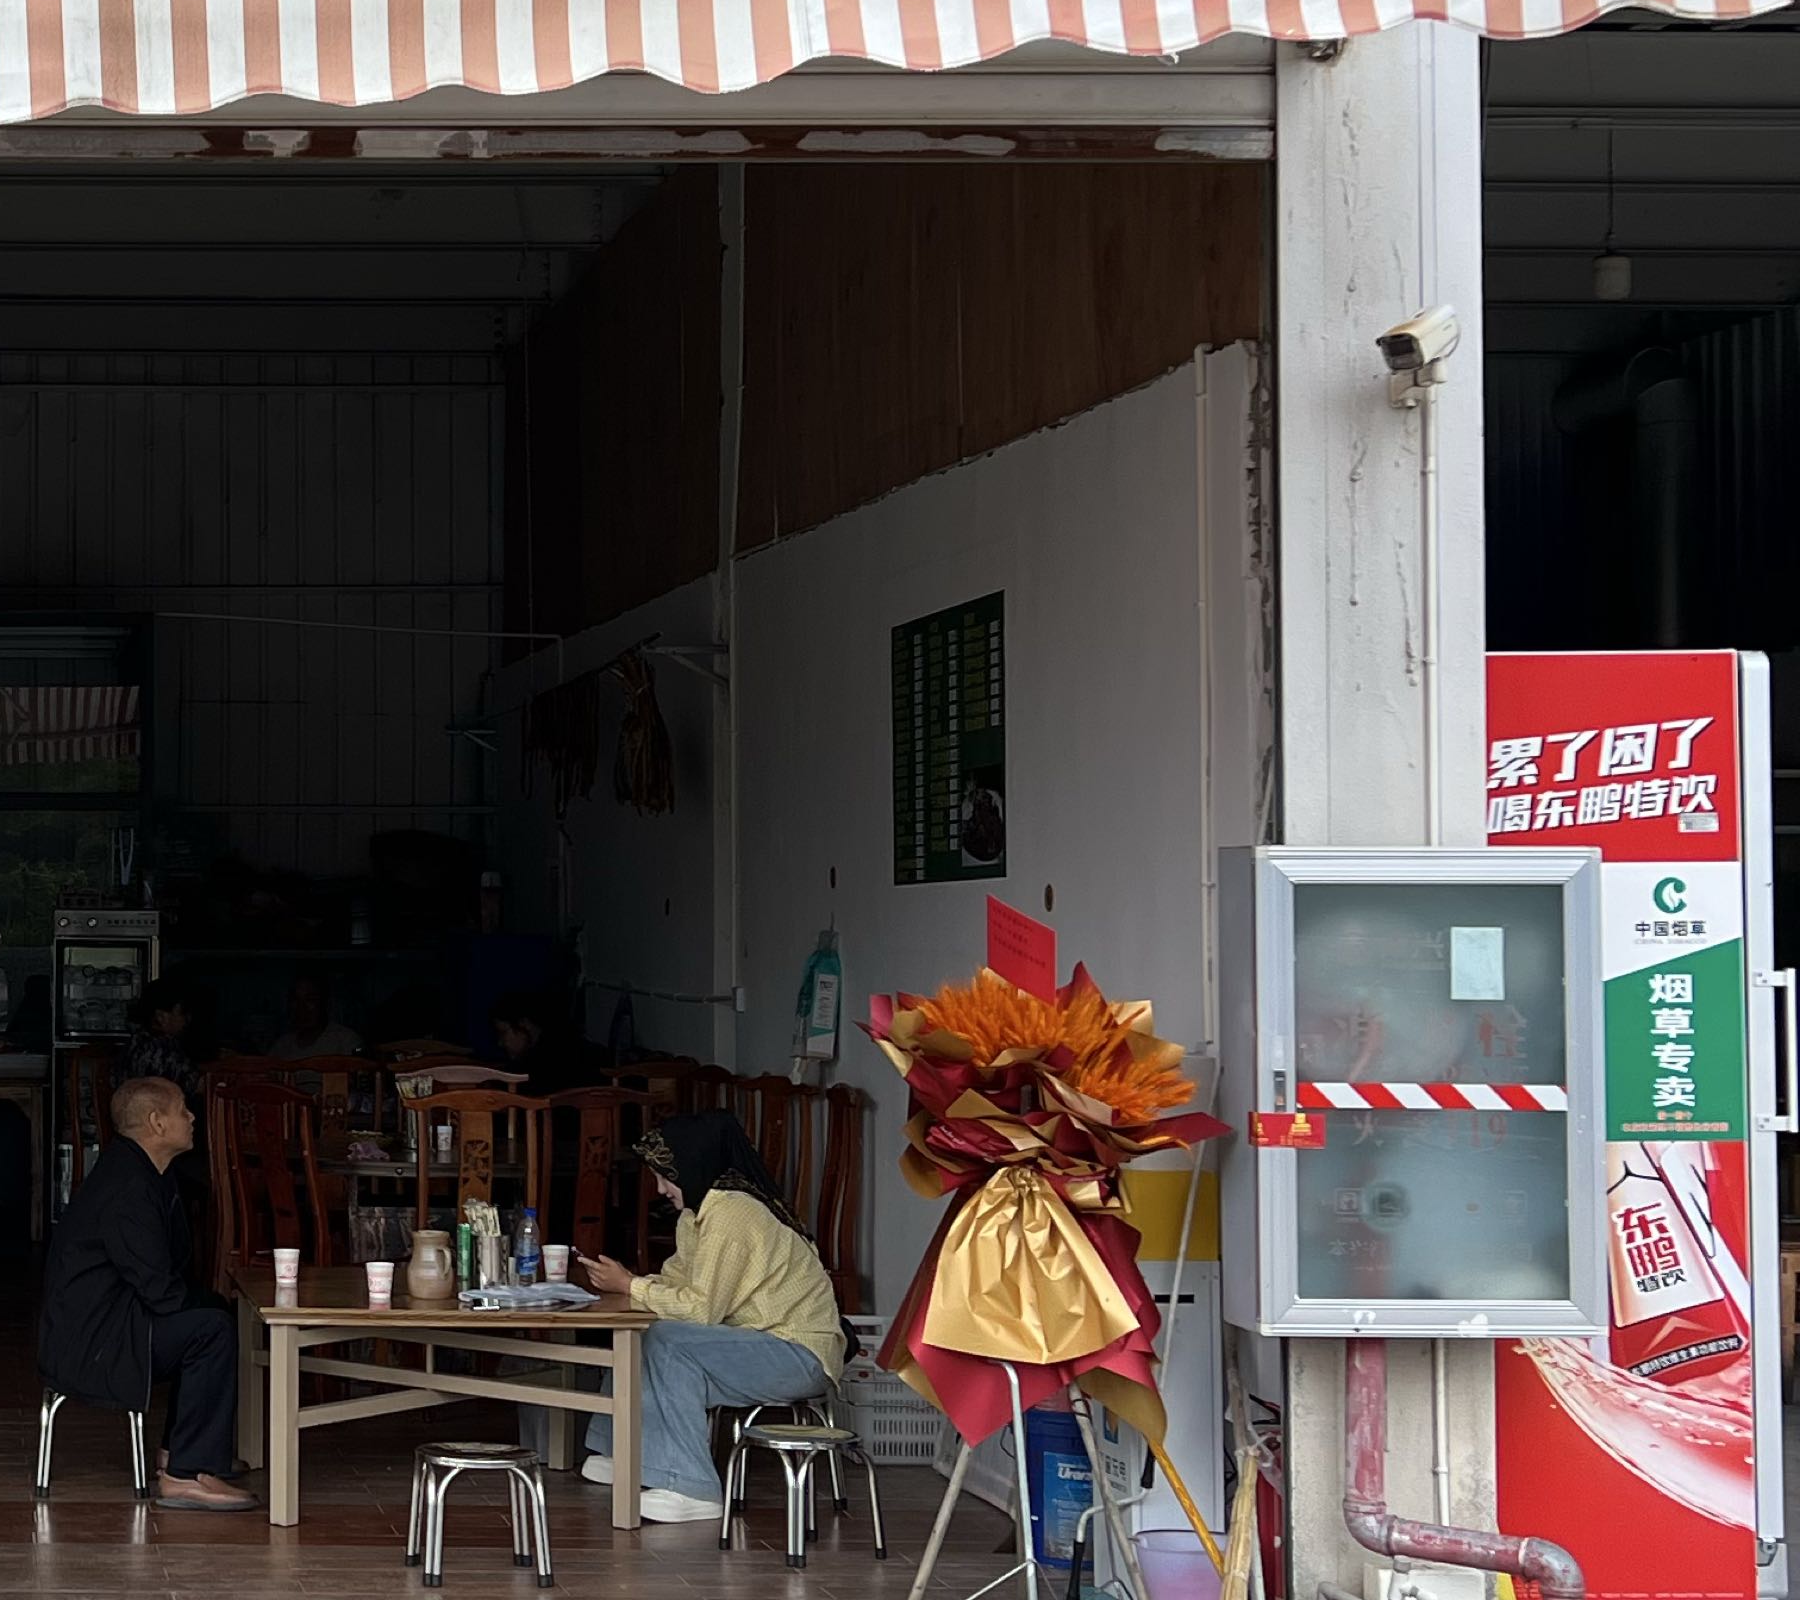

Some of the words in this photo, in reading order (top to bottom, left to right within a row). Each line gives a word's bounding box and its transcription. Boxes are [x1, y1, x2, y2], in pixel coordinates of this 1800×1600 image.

[1486, 717, 1714, 789] 累了困了
[1487, 774, 1717, 833] 喝东鹏特饮
[1635, 920, 1707, 937] 中国烟草
[1649, 973, 1696, 1107] 烟草专卖
